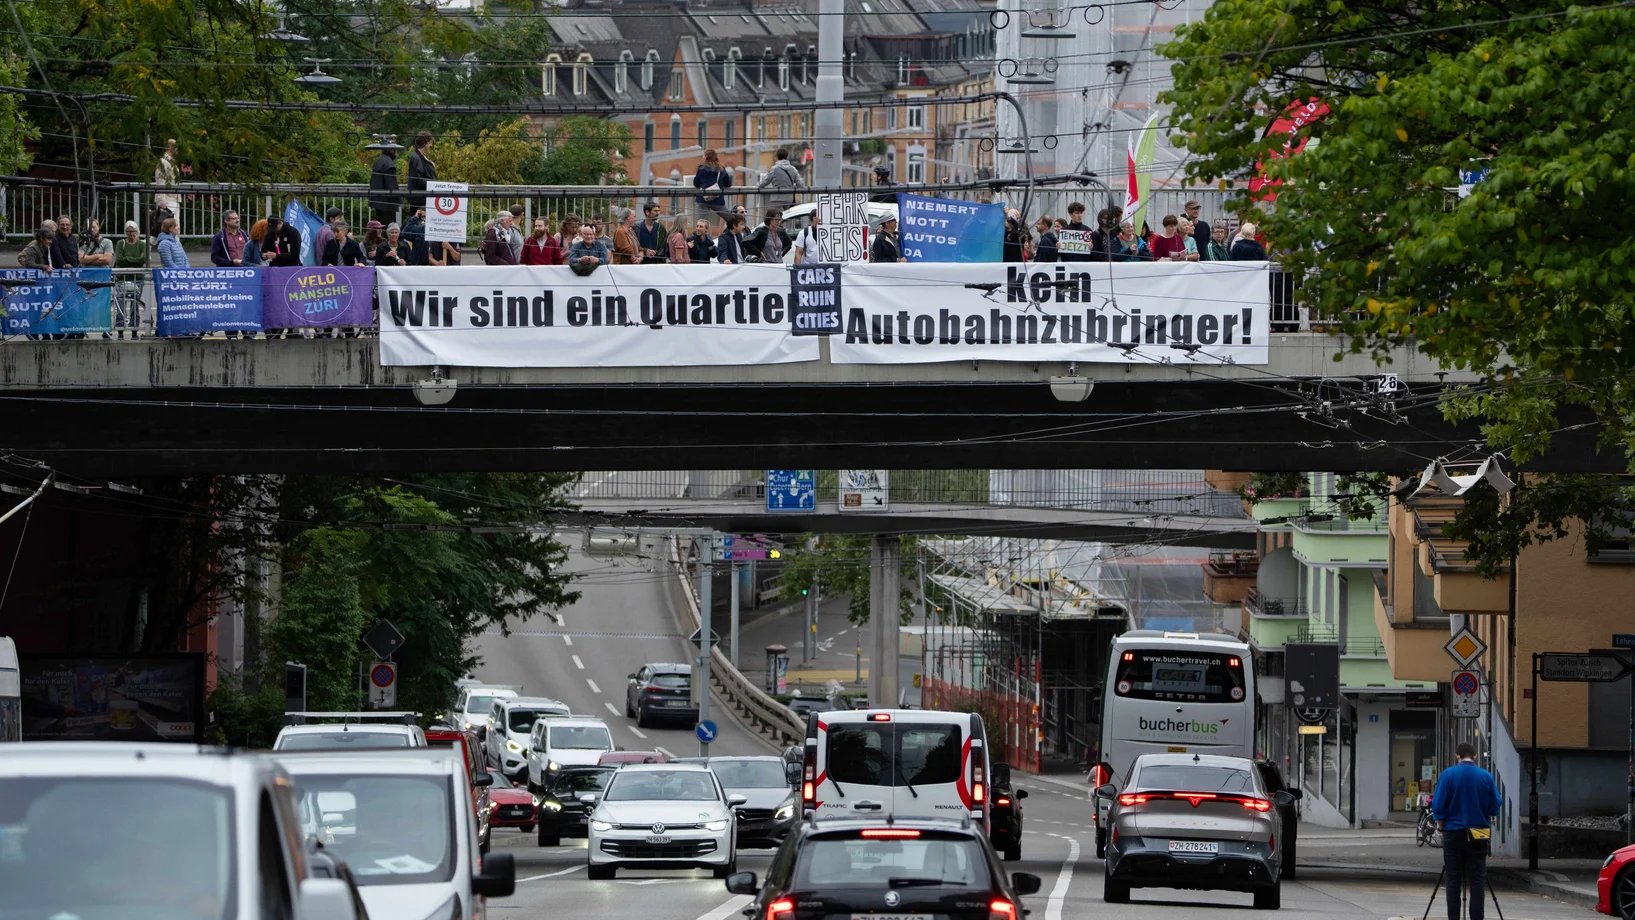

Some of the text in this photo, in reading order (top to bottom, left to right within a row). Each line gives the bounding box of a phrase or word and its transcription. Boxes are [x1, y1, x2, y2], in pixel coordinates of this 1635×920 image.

[1289, 103, 1316, 135] VELO
[442, 198, 452, 208] 30
[906, 200, 978, 215] NIEMERT
[818, 192, 868, 225] FEHR
[905, 216, 949, 228] WOTT
[904, 232, 957, 246] AUTOS
[1060, 231, 1083, 240] TEMPO
[818, 226, 868, 262] REIS!
[1062, 242, 1088, 252] JETZT
[904, 248, 922, 258] DA
[6, 270, 82, 279] NIEMERT
[160, 270, 255, 278] VISION ZERO
[797, 268, 835, 285] CARS
[161, 280, 189, 290] FÜR
[298, 273, 336, 288] VELO
[1007, 266, 1092, 304] kein
[288, 285, 350, 302] MÄNSCHE
[798, 290, 835, 307] RUIN
[162, 295, 204, 303] Mobilität
[8, 302, 64, 312] AUTOS
[163, 302, 236, 312] Menschenleben
[304, 298, 338, 314] ZÜRI
[388, 290, 458, 328] Wir
[470, 290, 553, 328] sind
[567, 289, 626, 327] ein
[164, 312, 197, 320] kosten!
[796, 312, 839, 329] CITIES
[10, 319, 30, 328] DA
[845, 308, 1252, 347] Autobahnzubringer!
[773, 474, 788, 482] Chur
[797, 482, 811, 490] Bern
[1143, 656, 1221, 665] www.buchertravel.ch
[1557, 658, 1578, 666] Spitex
[1158, 670, 1194, 680] GATE
[1546, 668, 1612, 678] Standort Wipkingen
[1155, 692, 1206, 700] SETRA
[1139, 716, 1218, 734] bucherbus
